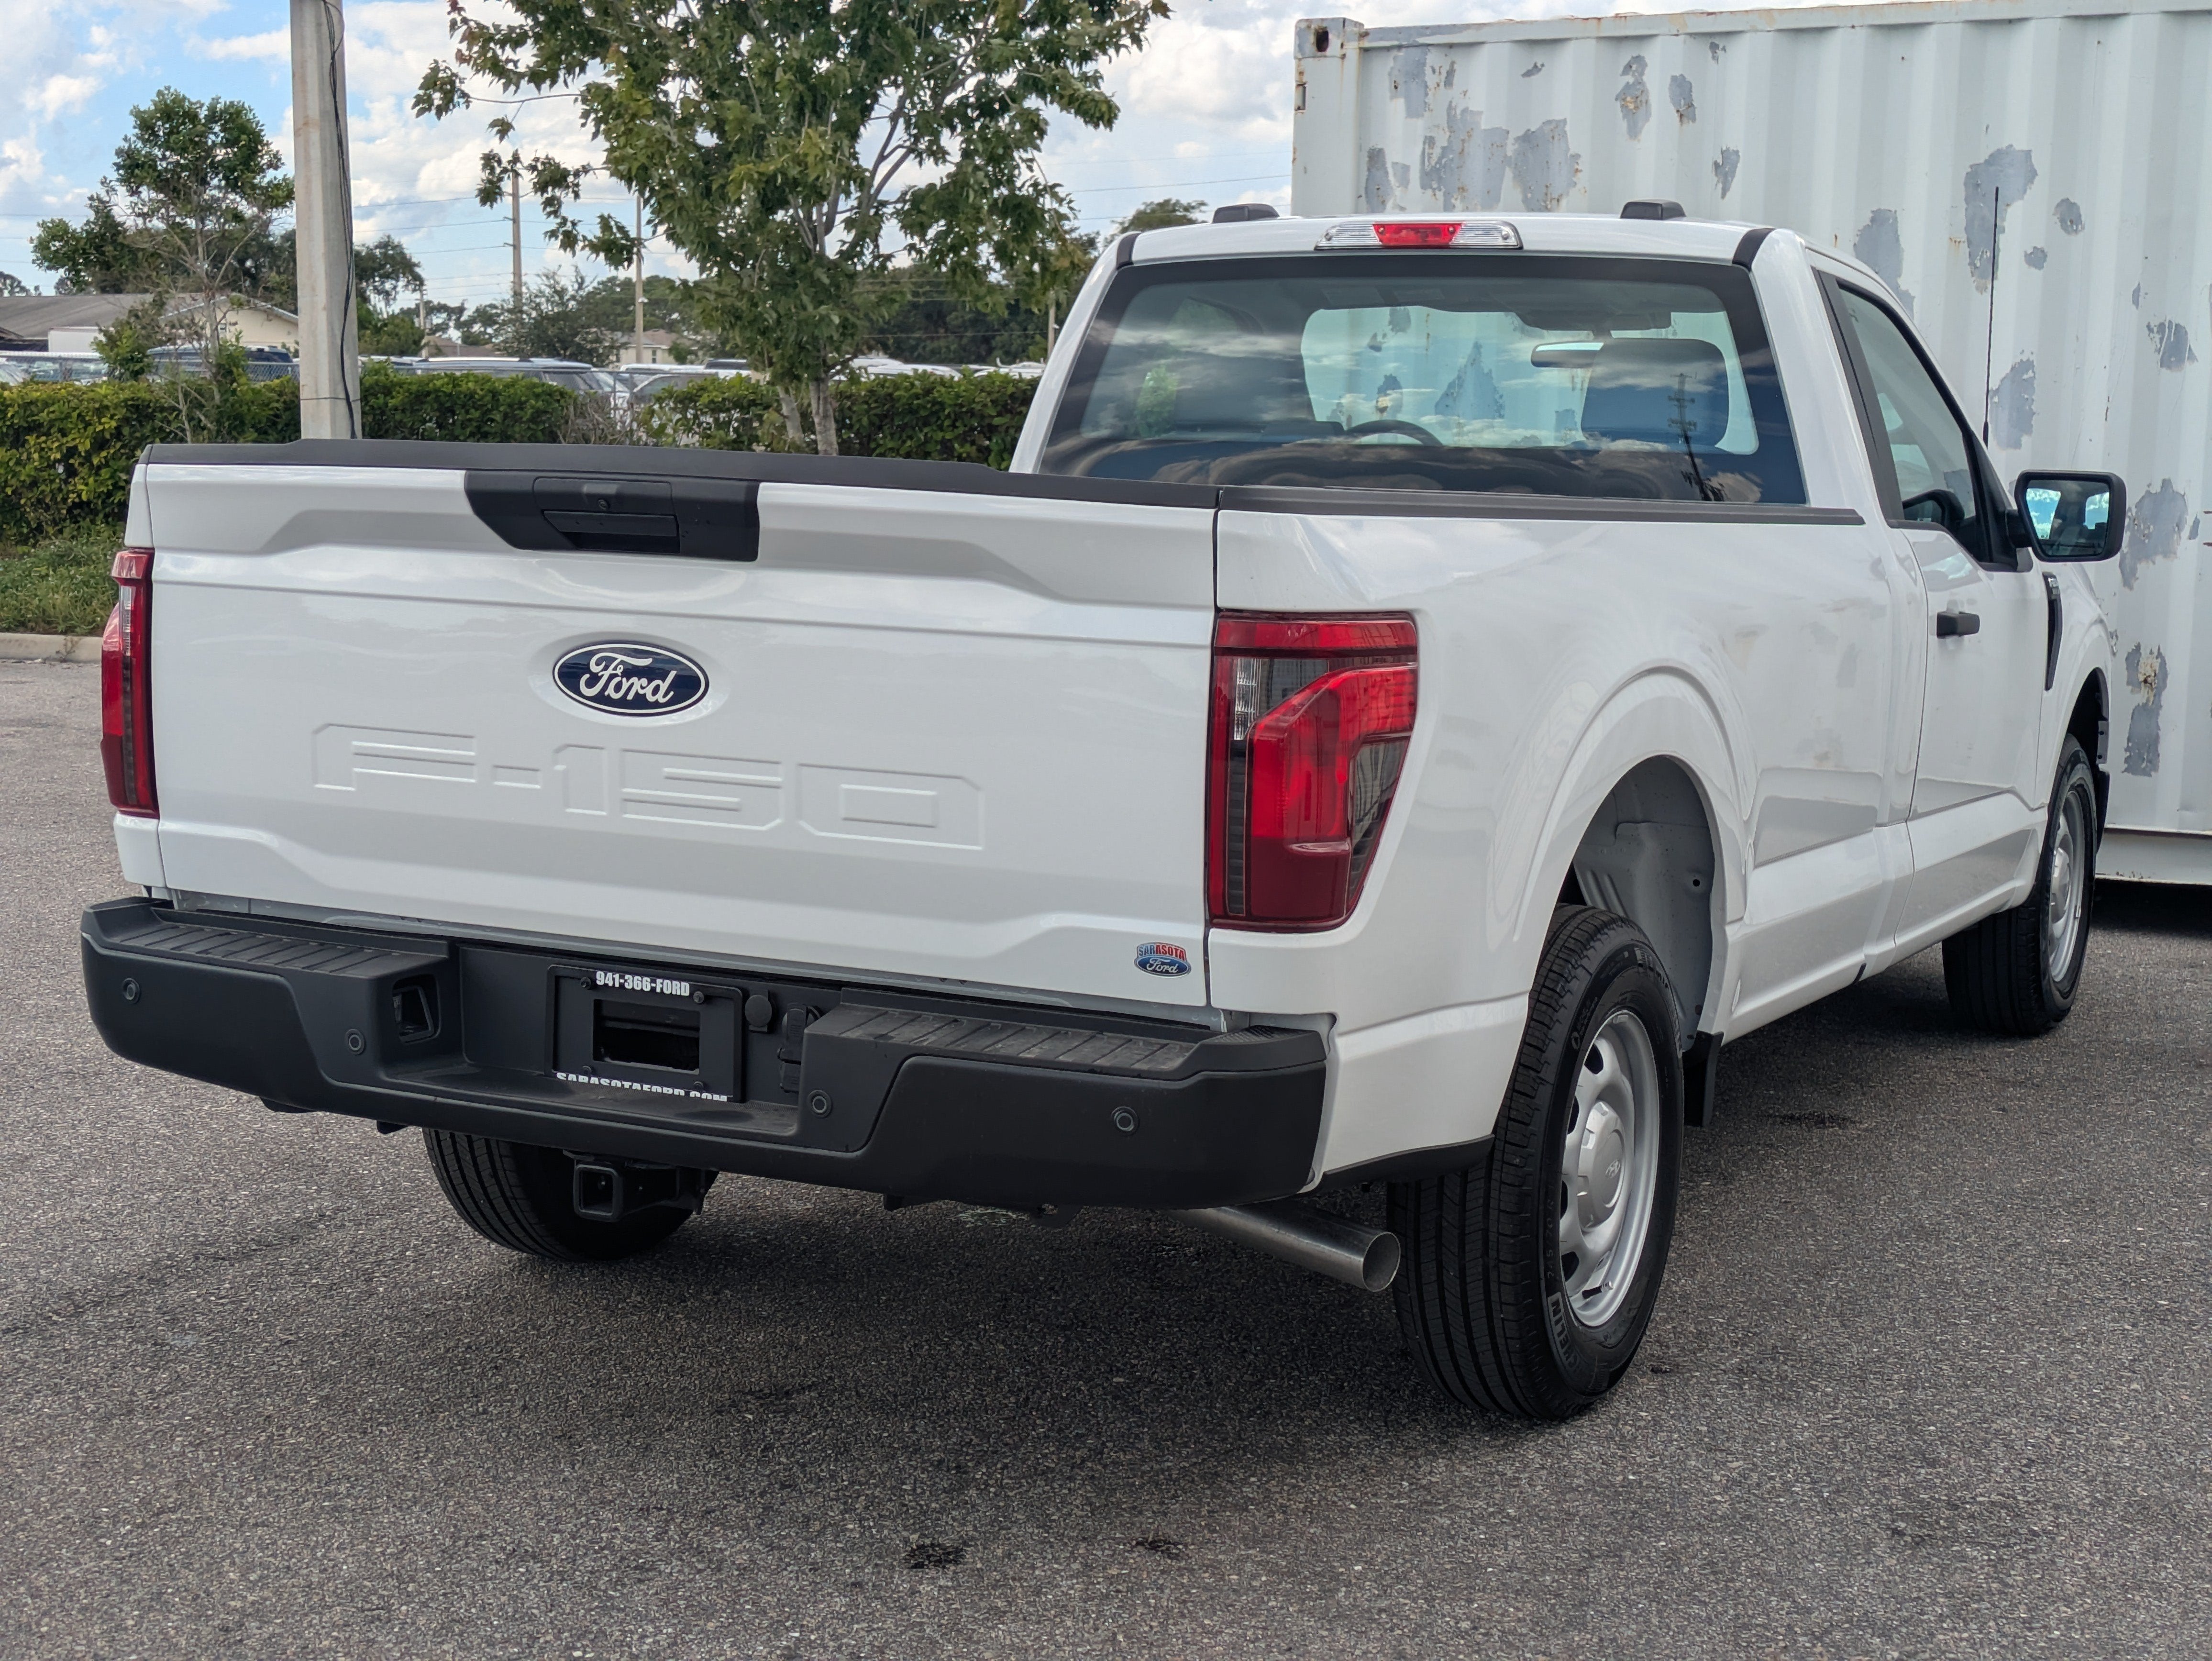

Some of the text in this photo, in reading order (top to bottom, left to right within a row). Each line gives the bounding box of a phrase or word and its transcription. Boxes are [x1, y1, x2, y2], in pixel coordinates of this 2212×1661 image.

[579, 652, 677, 703] Ford
[312, 723, 983, 850] F-150
[1139, 944, 1185, 961] SARASOTA
[1146, 957, 1179, 973] Ford
[596, 971, 690, 997] 941-366-FORD
[556, 1072, 728, 1102] SARASOTAFORDCOM
